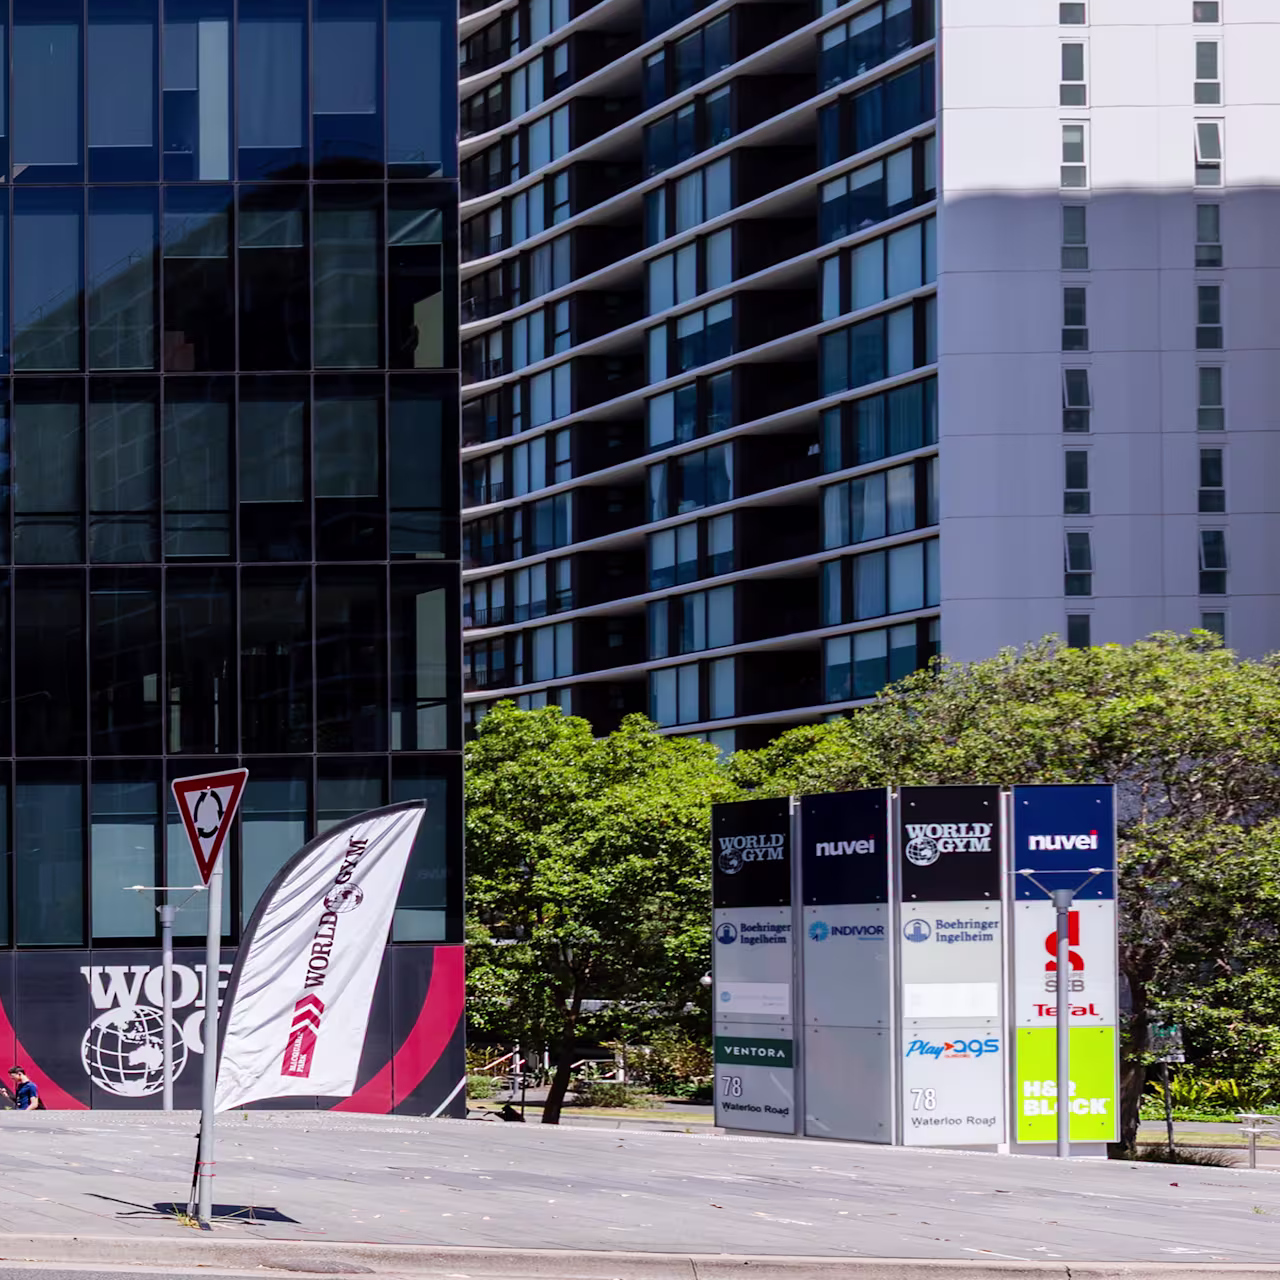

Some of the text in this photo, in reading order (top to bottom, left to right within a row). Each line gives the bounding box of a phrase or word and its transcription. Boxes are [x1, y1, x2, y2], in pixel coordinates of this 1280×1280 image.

[905, 823, 991, 839] WORLD
[718, 833, 784, 850] WORLD
[815, 834, 875, 857] nuvei
[937, 837, 991, 853] GYM
[1028, 830, 1098, 851] nuvei
[741, 847, 784, 862] GYM
[304, 837, 369, 989] WORLD GYM
[740, 922, 792, 933] Boehringer
[831, 925, 884, 936] INDIVIOR
[935, 919, 999, 930] Boehringer
[740, 934, 787, 945] Ingelheim
[935, 932, 993, 944] Ingelheim
[1032, 1003, 1100, 1017] Teal
[724, 1046, 786, 1058] VENTORA
[906, 1039, 945, 1060] Play
[722, 1076, 742, 1097] 78
[910, 1087, 937, 1111] 78
[722, 1102, 790, 1115] Waterloo Road
[911, 1116, 997, 1126] Waterloo Road
